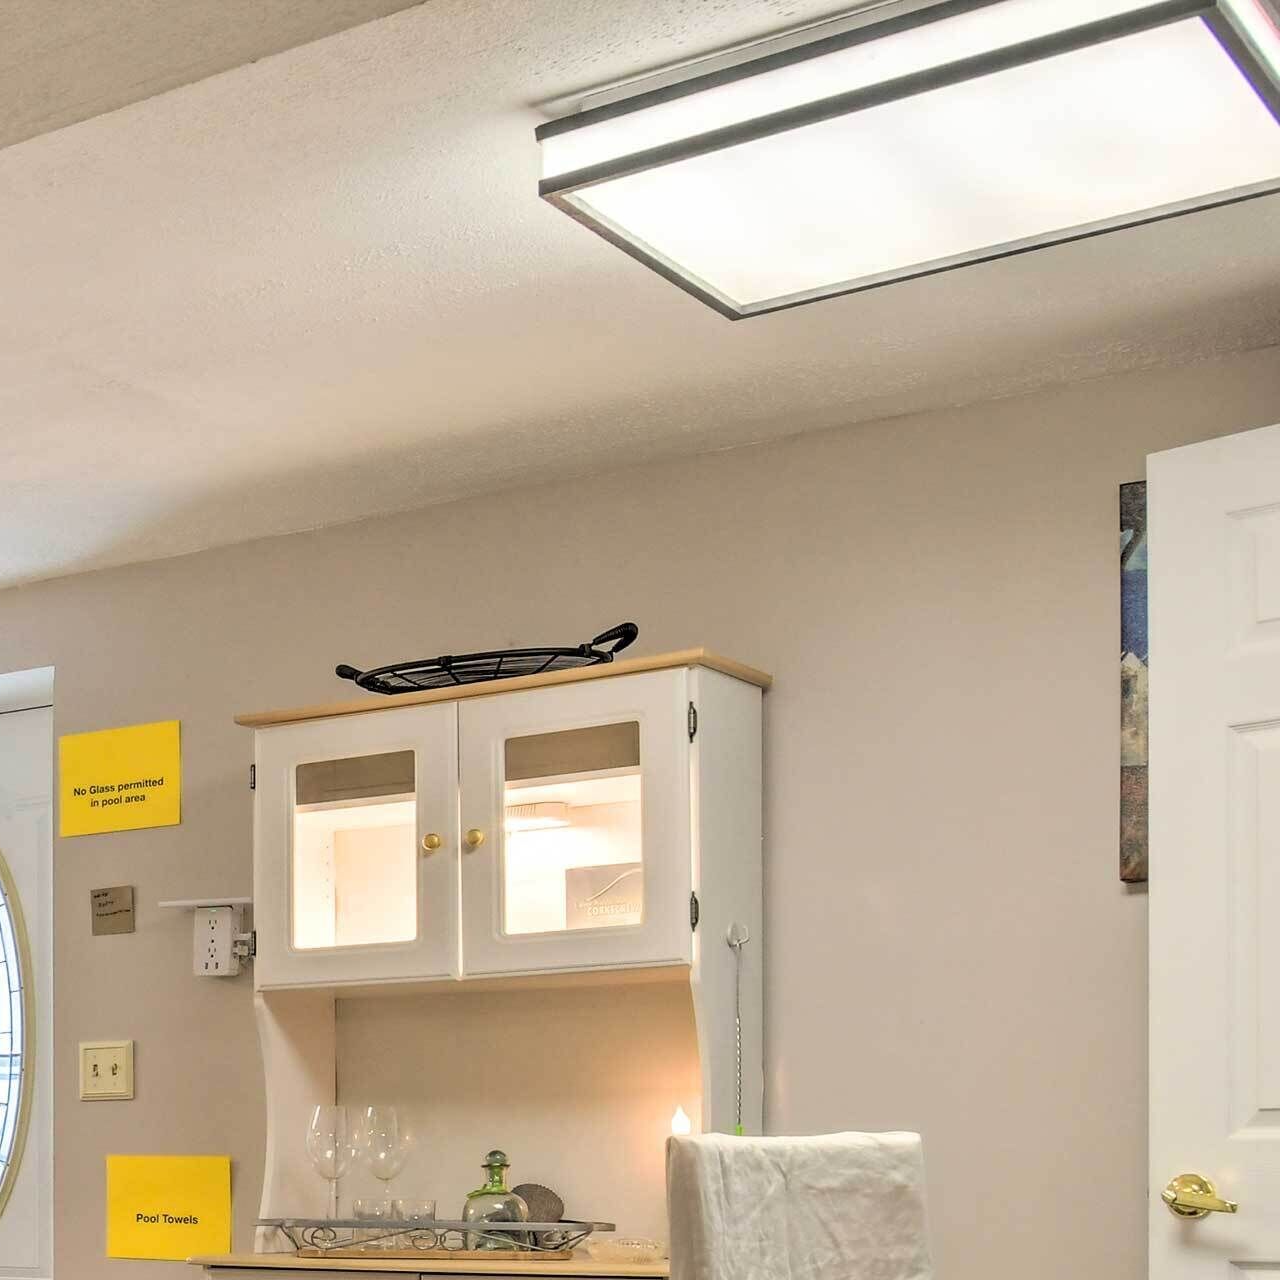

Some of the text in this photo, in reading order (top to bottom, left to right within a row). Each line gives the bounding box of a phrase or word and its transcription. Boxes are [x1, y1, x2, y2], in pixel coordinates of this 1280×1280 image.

[73, 777, 164, 796] No Glass permitted
[90, 794, 146, 808] in pool area
[136, 1213, 199, 1225] Pool Towels
